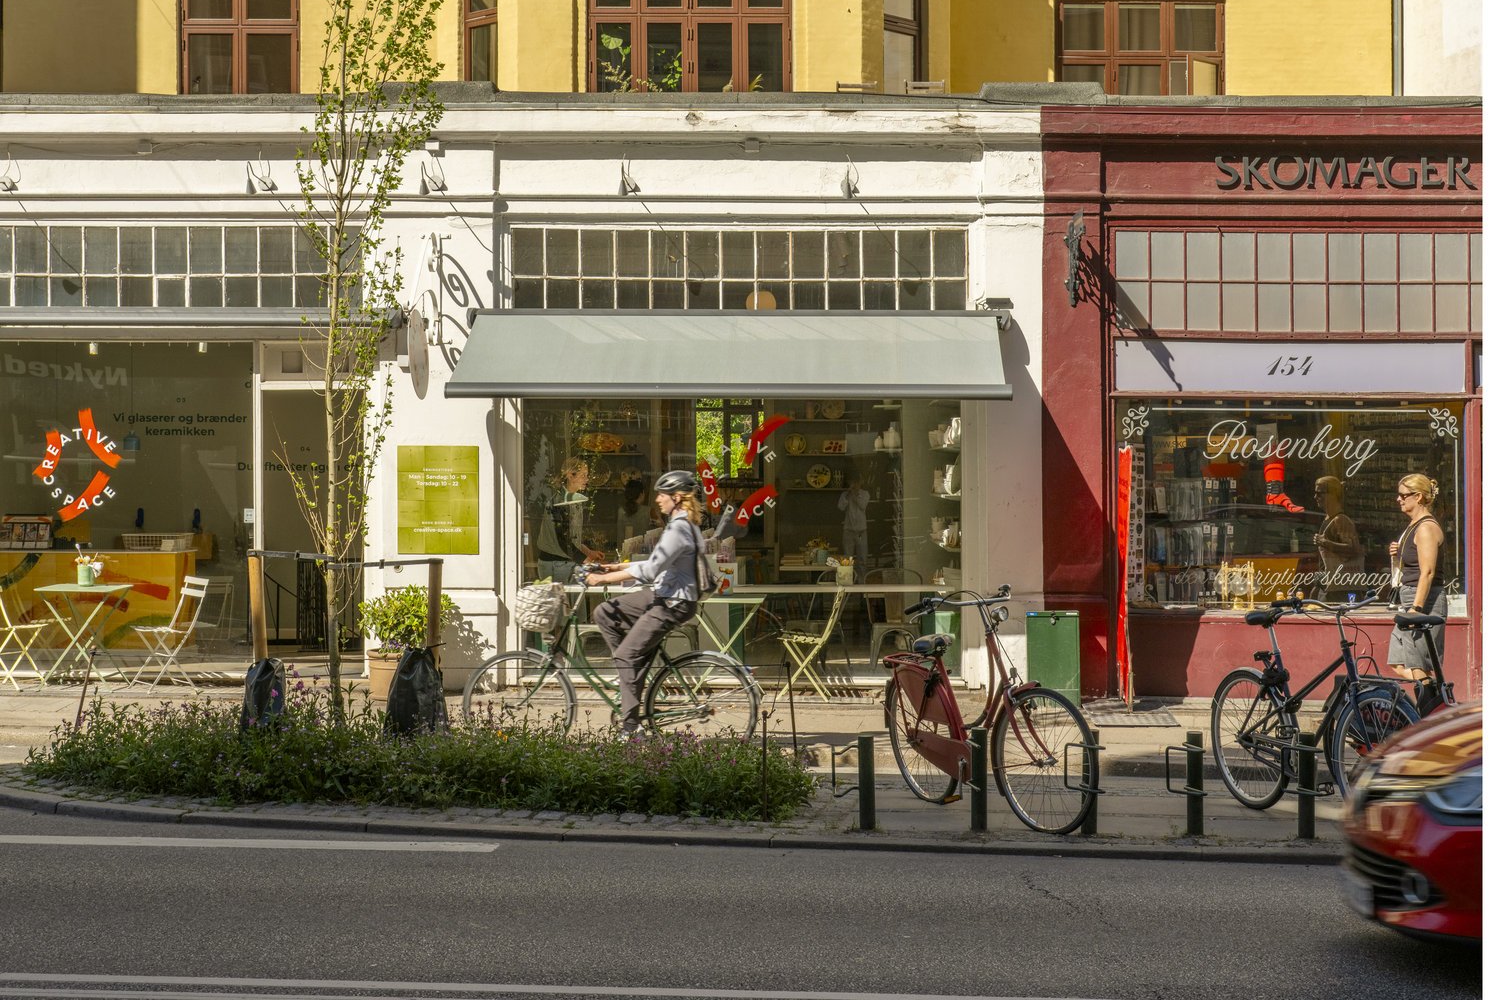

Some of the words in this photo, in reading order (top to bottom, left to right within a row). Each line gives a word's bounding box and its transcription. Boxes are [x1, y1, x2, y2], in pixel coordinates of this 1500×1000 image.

[1214, 155, 1479, 191] SKOMAGER
[1267, 354, 1314, 377] 154
[113, 412, 125, 423] Vi
[128, 412, 175, 427] glaserer
[178, 414, 194, 427] og
[196, 412, 248, 424] brænder
[145, 425, 215, 437] keramikken
[41, 427, 117, 486] CREATIVE
[1202, 419, 1379, 478] Rosenberg
[701, 437, 777, 496] CREATIVE
[51, 486, 117, 511] SPACE
[711, 495, 777, 520] SPACE
[1320, 563, 1393, 597] skomag
